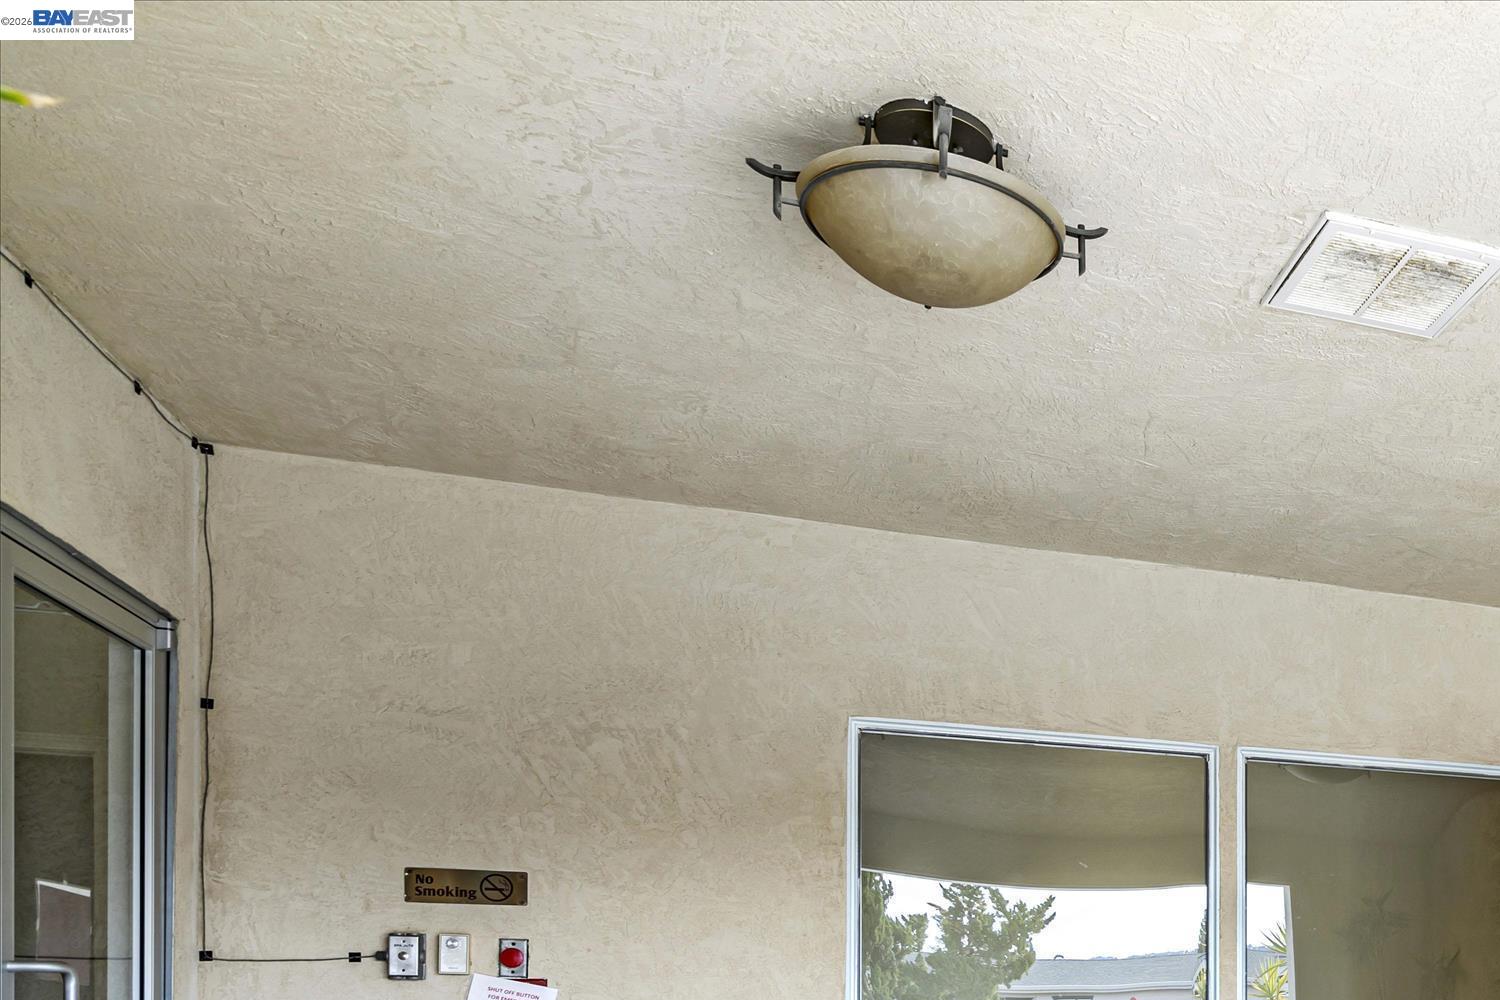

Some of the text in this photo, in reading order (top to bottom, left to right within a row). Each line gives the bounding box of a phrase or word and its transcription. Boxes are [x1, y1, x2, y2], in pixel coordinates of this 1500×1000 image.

[415, 874, 434, 884] No
[415, 886, 477, 900] Smoking
[516, 991, 540, 1000] BUTTON
